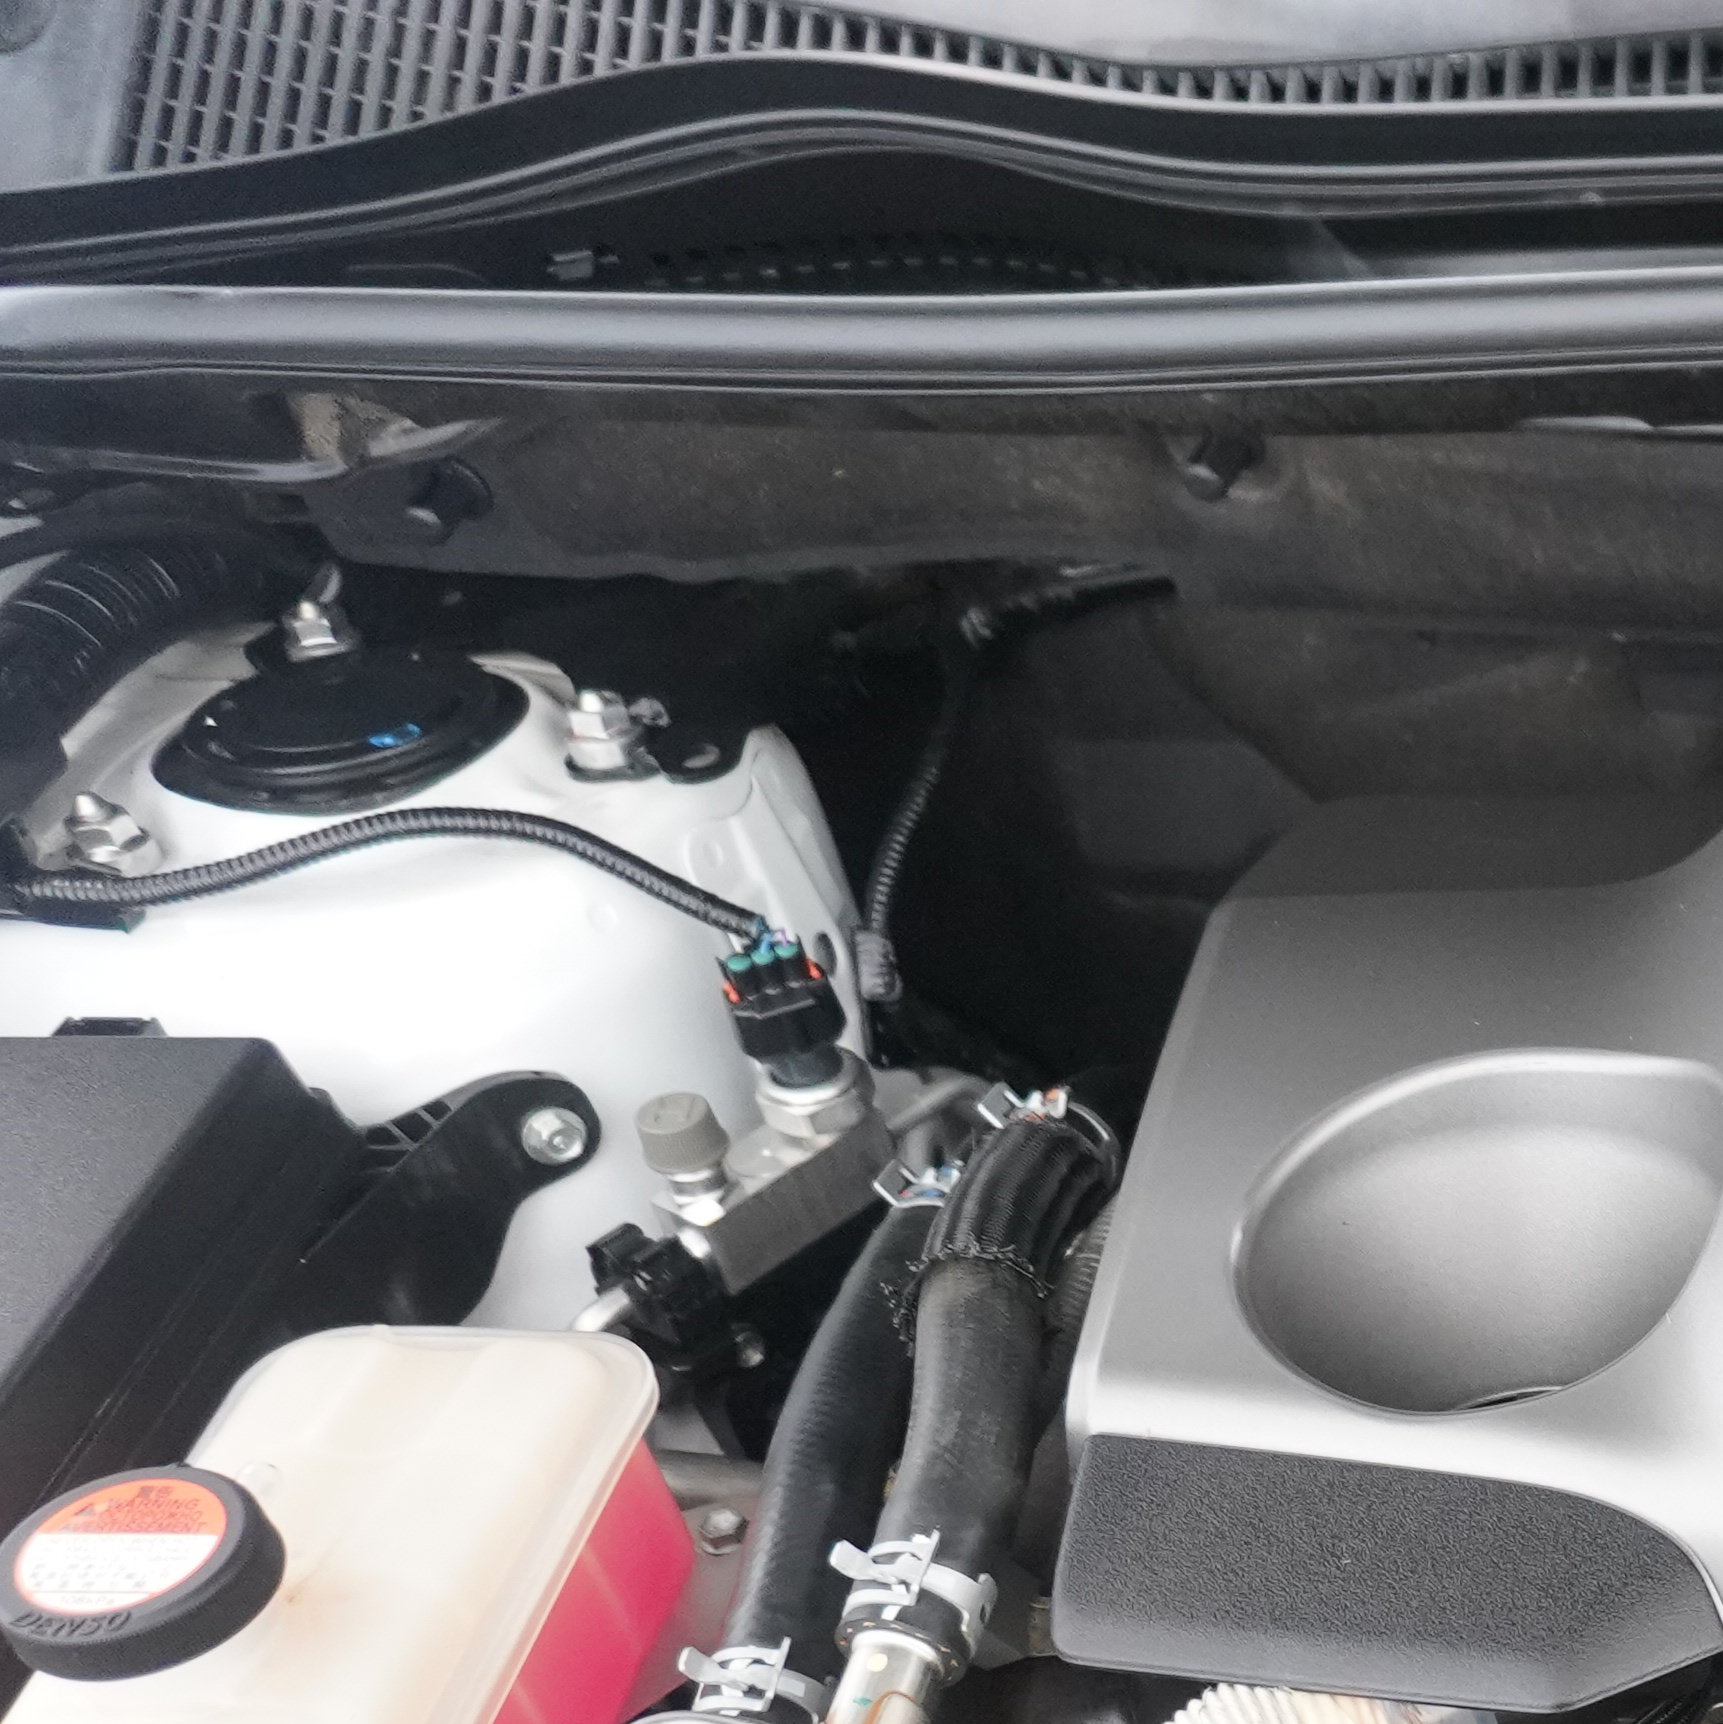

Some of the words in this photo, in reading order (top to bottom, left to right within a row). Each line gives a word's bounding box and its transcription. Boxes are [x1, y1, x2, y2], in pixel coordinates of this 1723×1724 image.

[108, 1498, 201, 1511] WARNING
[60, 1521, 208, 1534] AVERTISSEMENT
[10, 1609, 132, 1638] DENSO
